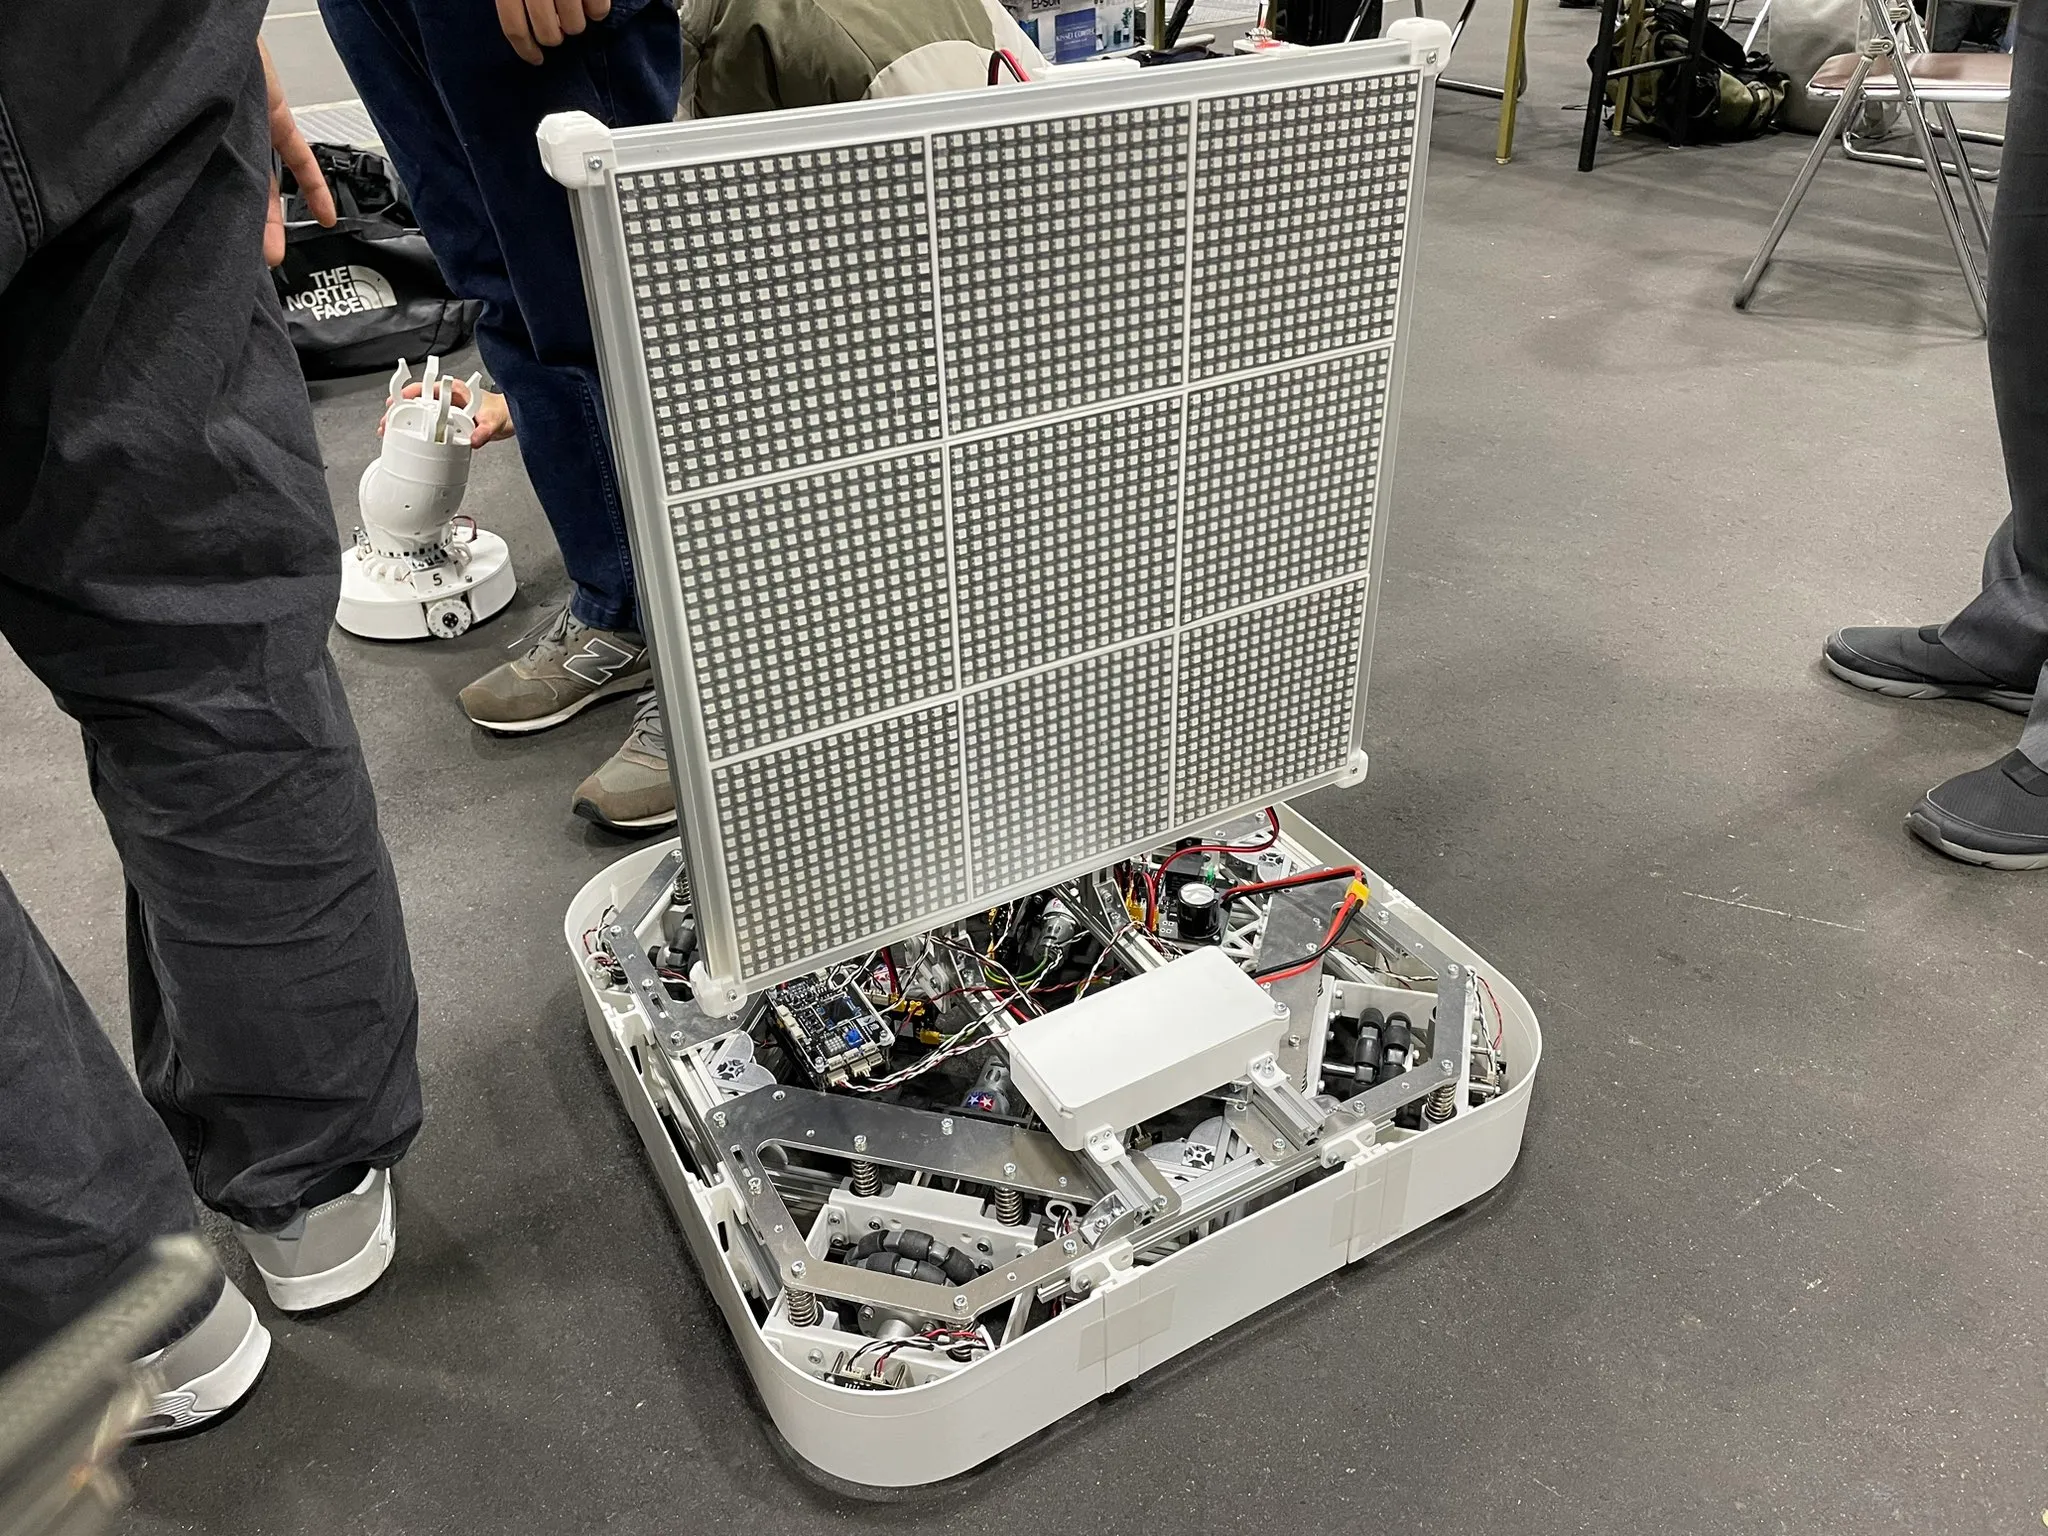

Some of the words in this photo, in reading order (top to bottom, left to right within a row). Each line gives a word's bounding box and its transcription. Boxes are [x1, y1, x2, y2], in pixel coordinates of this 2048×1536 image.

[309, 266, 350, 288] THE
[286, 282, 357, 311] NORTH
[311, 297, 363, 321] FACE
[433, 573, 442, 586] 5
